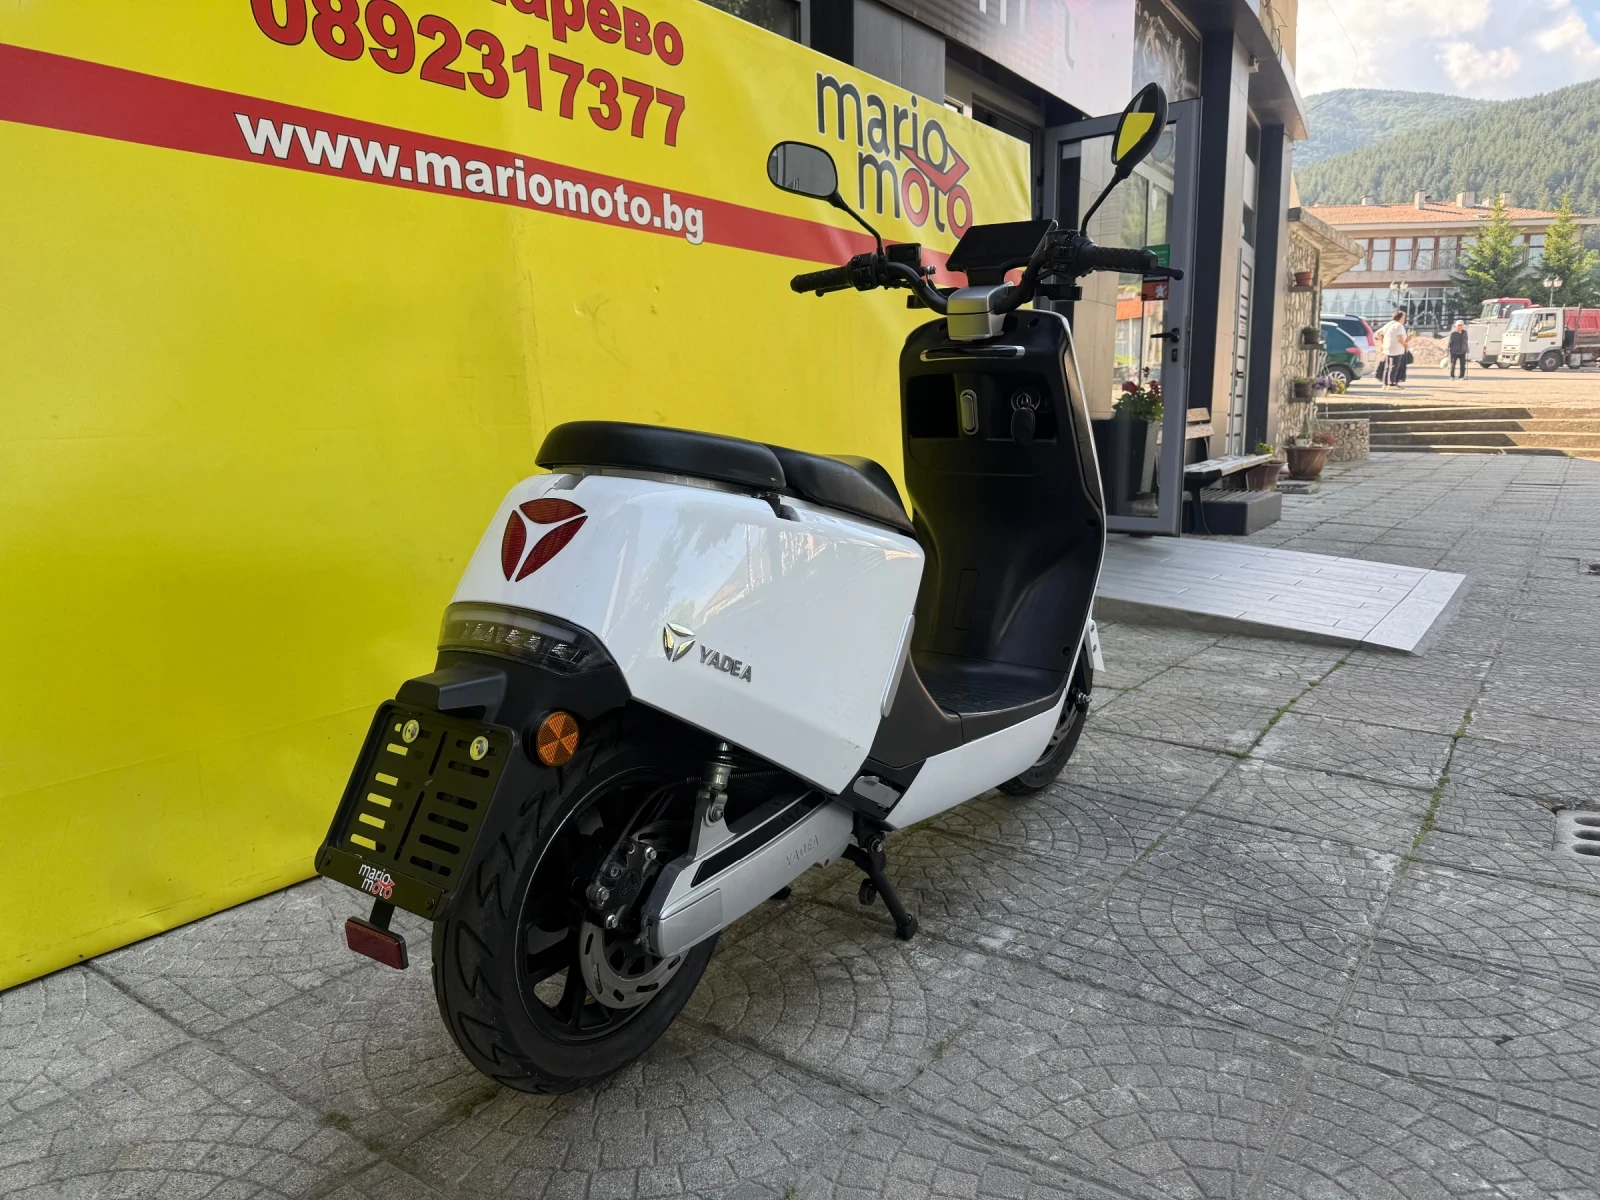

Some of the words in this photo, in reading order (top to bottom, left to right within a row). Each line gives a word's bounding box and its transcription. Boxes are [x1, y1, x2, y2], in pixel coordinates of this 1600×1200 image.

[250, 0, 686, 147] 0892317377
[815, 71, 949, 175] mario
[233, 112, 705, 245] www.mariomoto.bg
[857, 151, 974, 241] moto
[699, 644, 752, 683] YADEA
[358, 863, 391, 885] mario
[361, 878, 392, 899] moto
